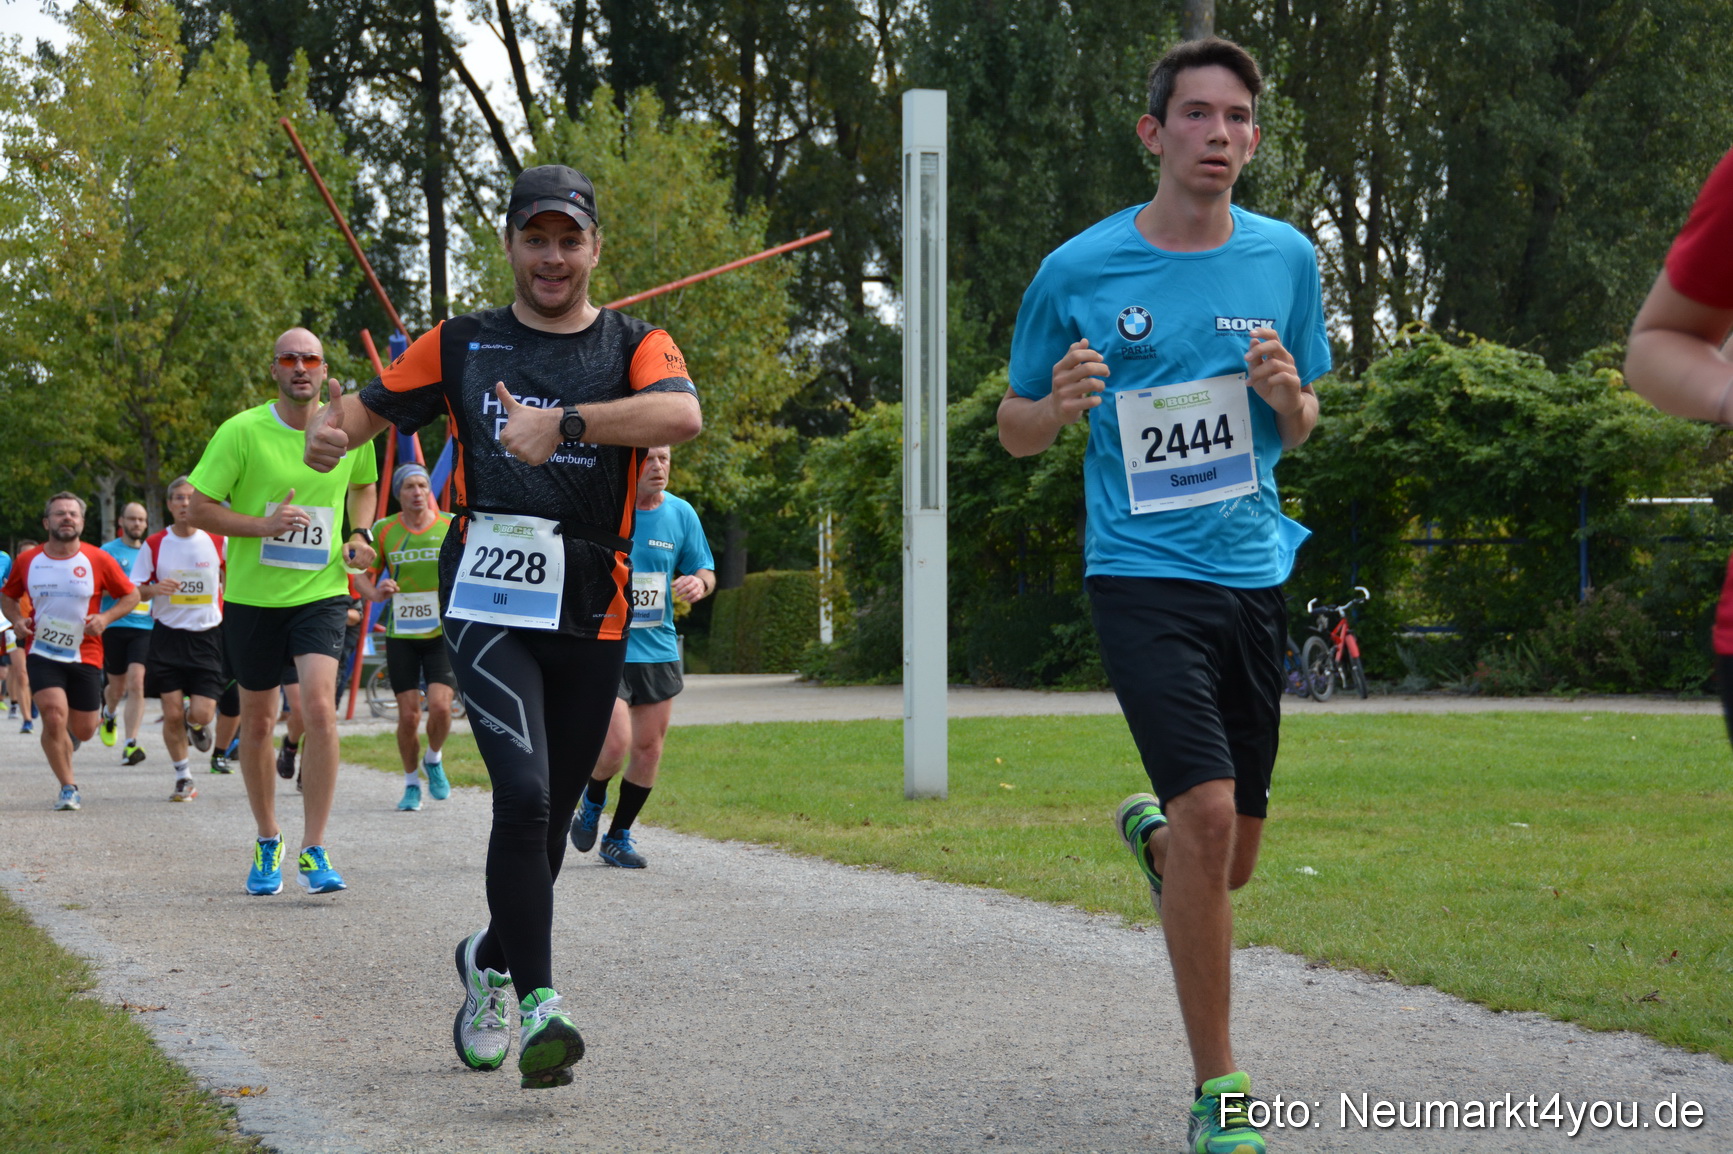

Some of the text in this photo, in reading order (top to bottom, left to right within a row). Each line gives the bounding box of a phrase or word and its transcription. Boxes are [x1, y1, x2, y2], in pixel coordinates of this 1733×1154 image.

[1120, 308, 1148, 320] BMW
[1215, 317, 1275, 331] BOCK
[1121, 344, 1156, 355] PARTL
[1166, 391, 1211, 408] BOCK
[1141, 414, 1234, 463] 2444
[1170, 467, 1217, 487] Samuel
[501, 525, 534, 537] BOCK
[649, 539, 674, 550] BOCK
[389, 548, 440, 565] BOC
[469, 546, 547, 584] 2228
[181, 581, 204, 593] 259
[493, 592, 508, 605] Uli
[400, 605, 432, 618] 2785
[42, 628, 75, 646] 2275
[480, 717, 506, 734] 2XU
